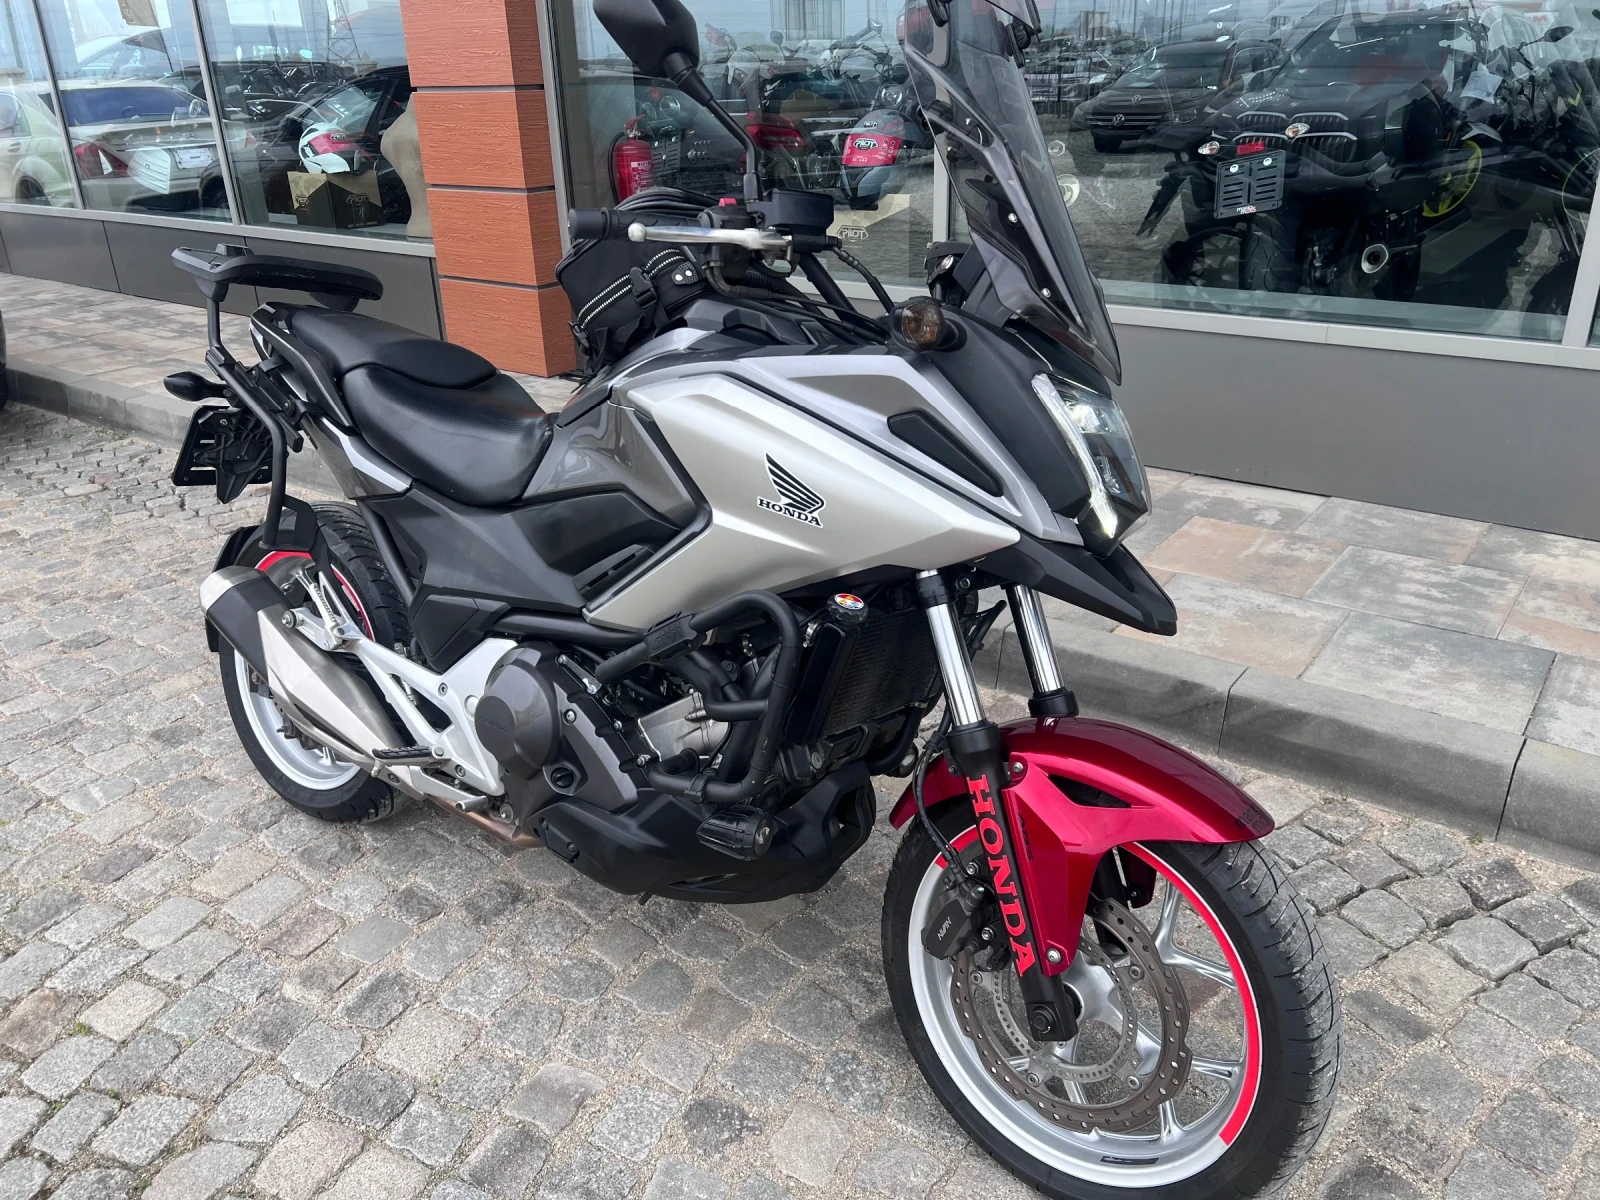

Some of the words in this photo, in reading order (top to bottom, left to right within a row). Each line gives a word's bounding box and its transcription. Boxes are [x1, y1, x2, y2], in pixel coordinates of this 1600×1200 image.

[841, 228, 865, 240] PILOT
[758, 497, 822, 527] HONDA
[966, 774, 1036, 977] HONDA
